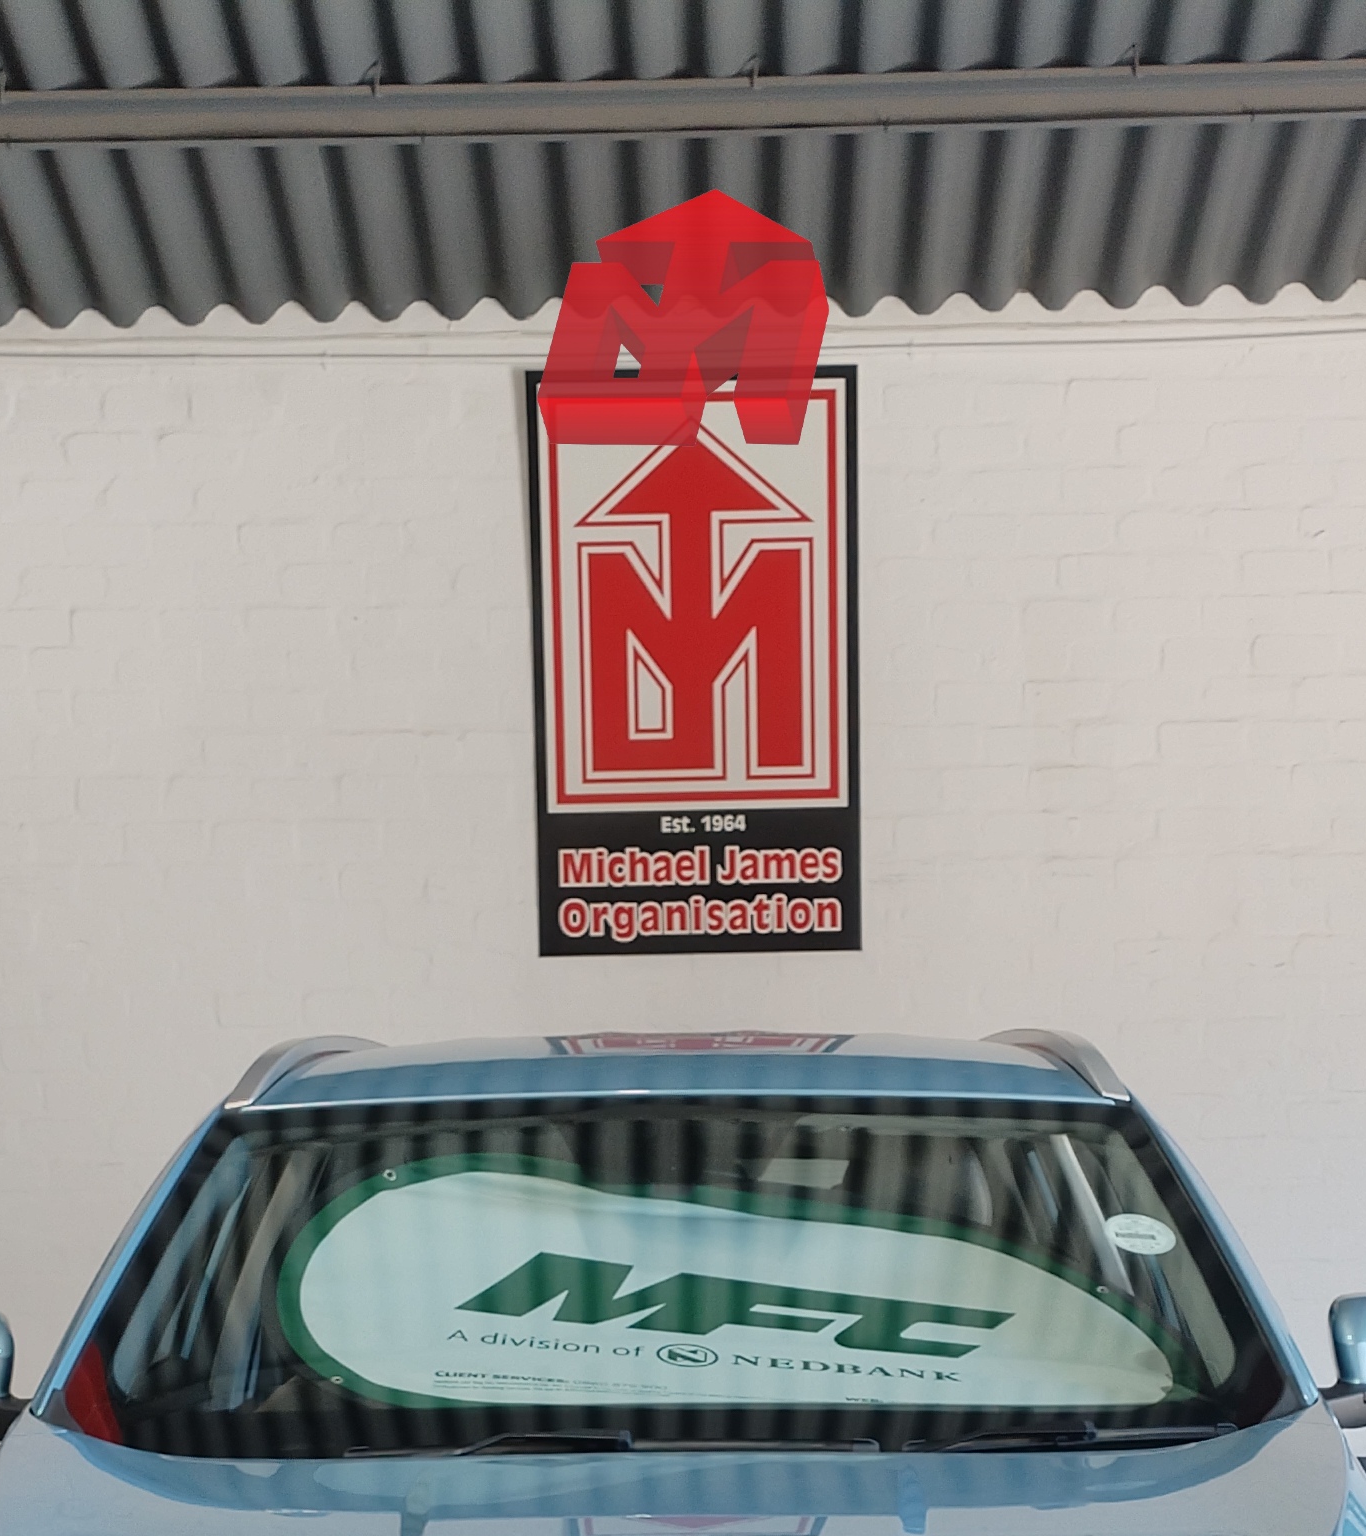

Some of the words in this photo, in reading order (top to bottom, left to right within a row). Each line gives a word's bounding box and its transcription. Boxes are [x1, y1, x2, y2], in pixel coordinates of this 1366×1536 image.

[660, 815, 696, 834] Est.
[700, 814, 747, 832] 1964
[559, 846, 710, 888] Michael
[718, 845, 843, 885] James
[559, 893, 843, 942] Organisation
[455, 1251, 1016, 1358] MFC
[447, 1329, 469, 1342] A
[480, 1332, 601, 1355] division
[612, 1344, 645, 1358] of
[732, 1353, 963, 1383] NEDBANK
